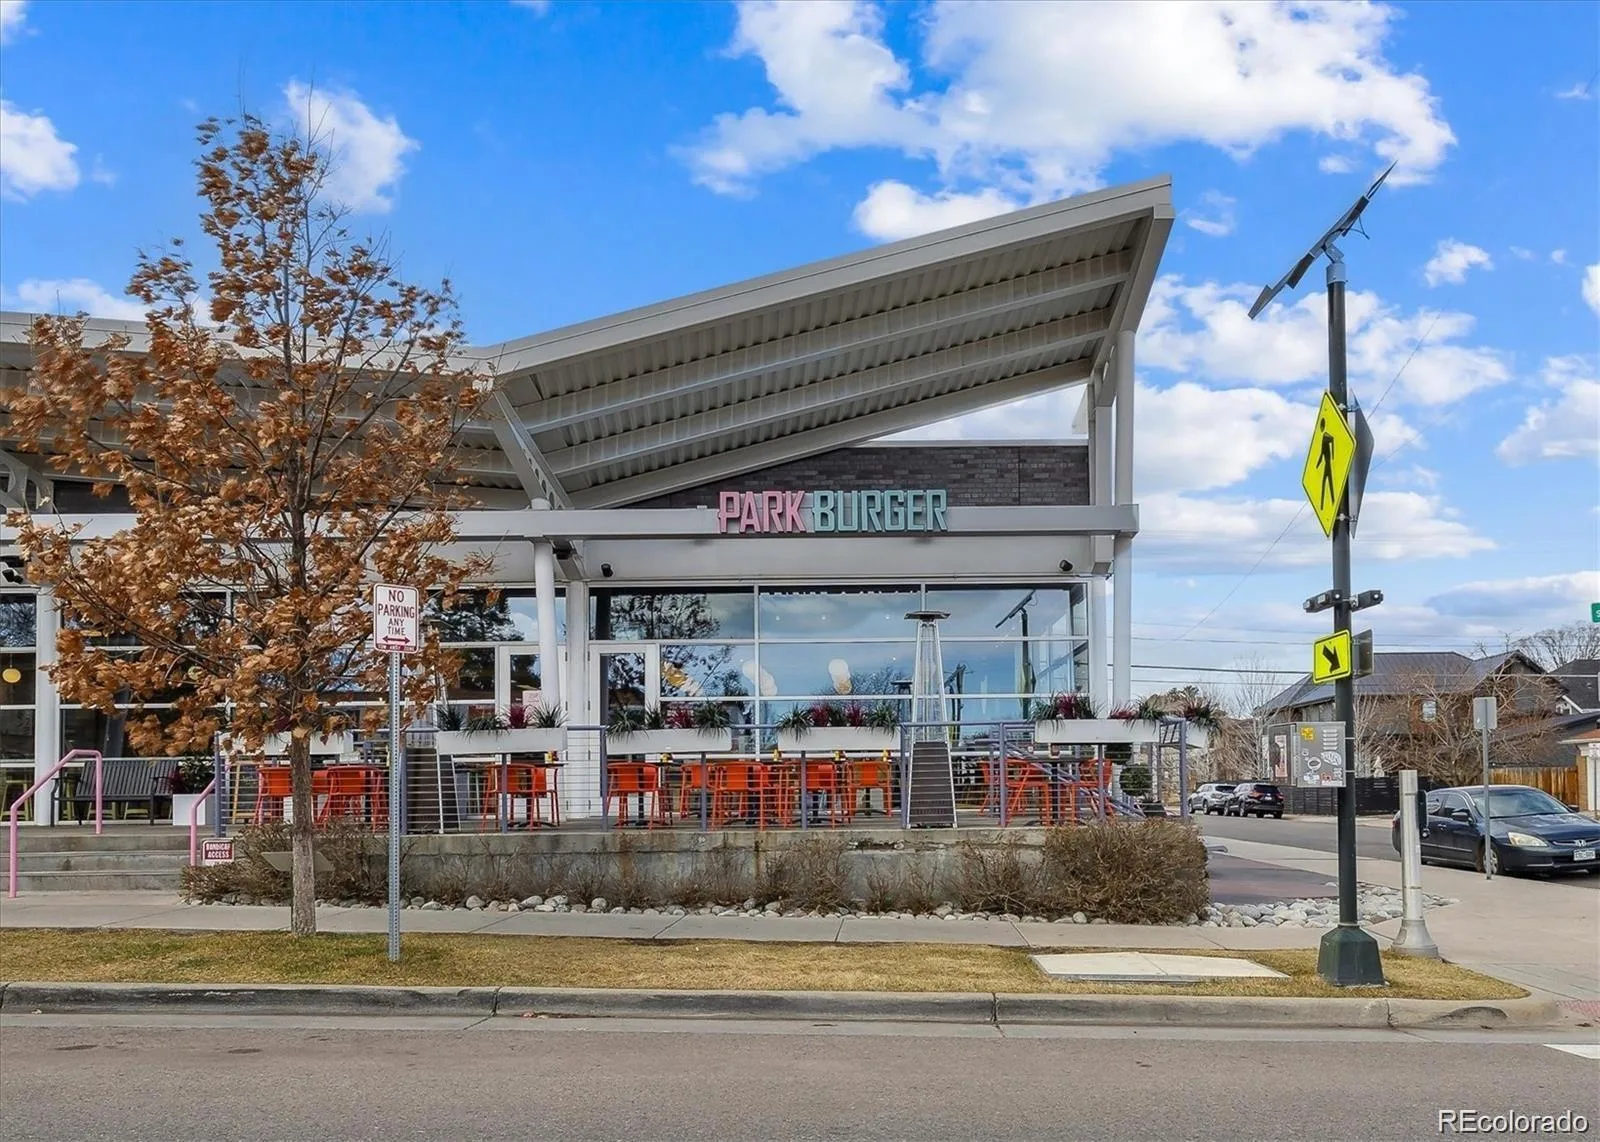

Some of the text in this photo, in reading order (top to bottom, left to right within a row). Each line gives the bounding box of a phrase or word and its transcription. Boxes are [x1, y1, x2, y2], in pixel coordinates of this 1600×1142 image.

[717, 489, 948, 533] PARK BURGER
[388, 590, 405, 603] NO
[377, 603, 415, 619] PARKING
[387, 618, 405, 627] ANY
[387, 626, 405, 636] TIME
[207, 850, 230, 859] ACCESS
